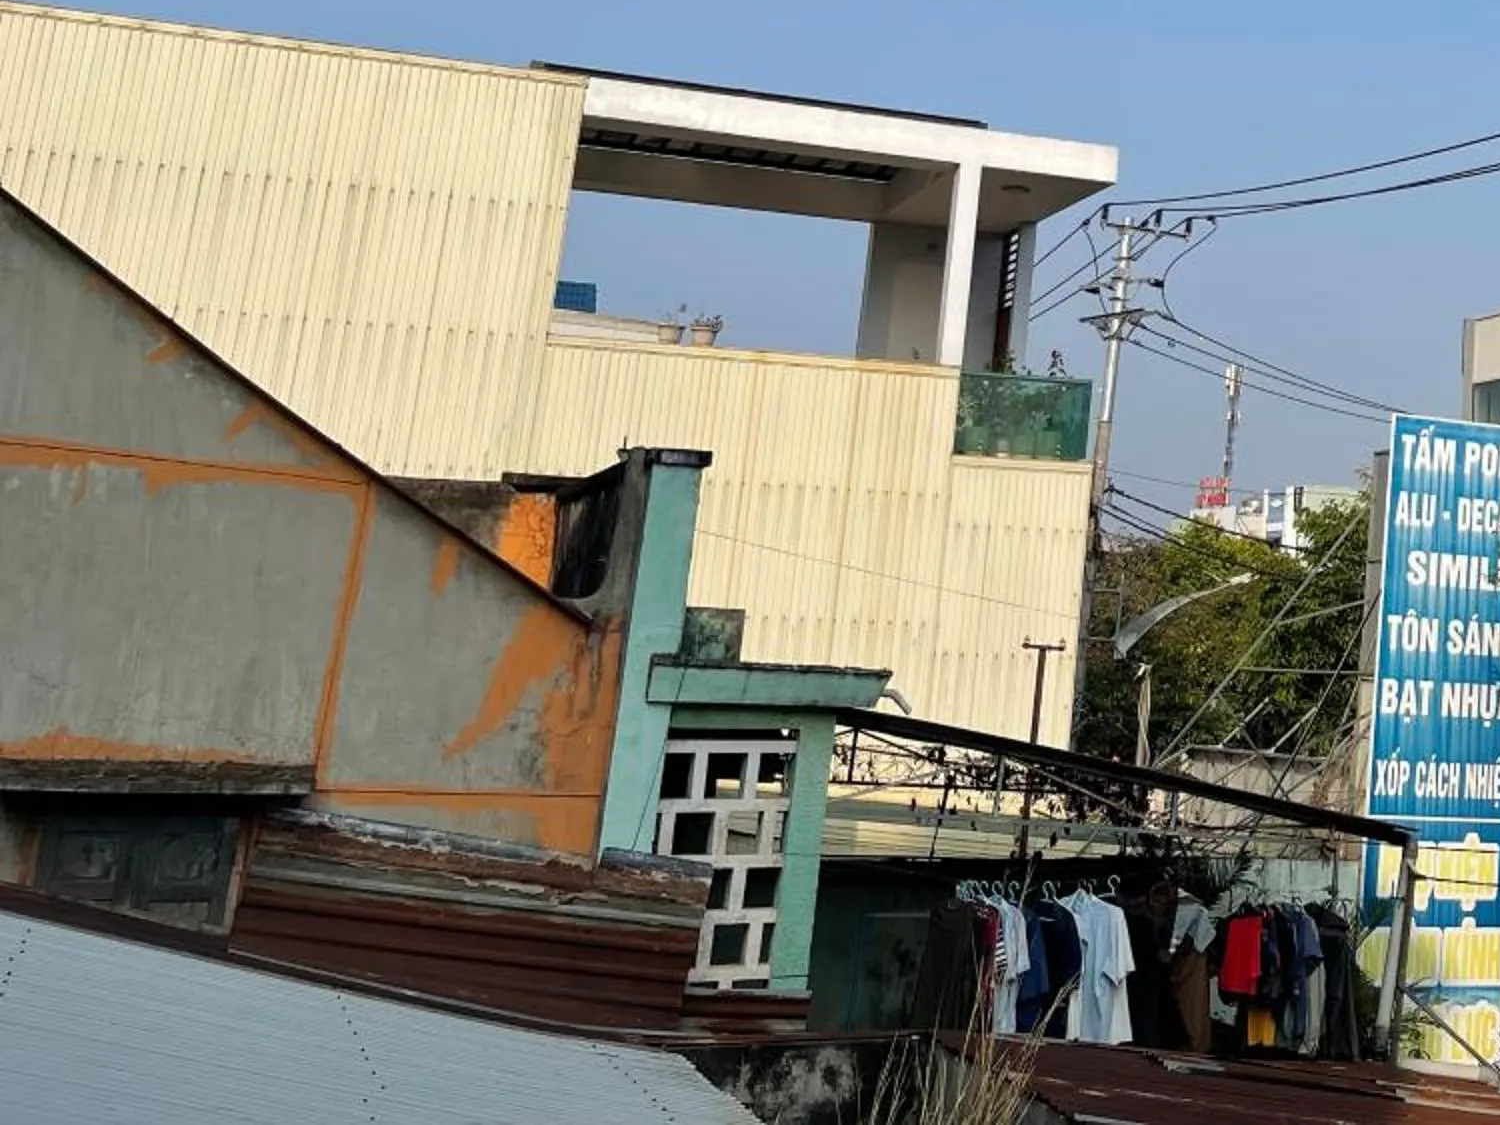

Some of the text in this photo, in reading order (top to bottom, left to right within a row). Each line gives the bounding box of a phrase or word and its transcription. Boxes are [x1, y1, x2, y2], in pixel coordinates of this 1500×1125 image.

[1401, 424, 1456, 473] TẤM
[1394, 490, 1437, 527] ALU
[1387, 609, 1439, 653] TÔN
[1380, 678, 1433, 723] BẠT
[1374, 747, 1410, 796] XỐP
[1415, 754, 1461, 798] CÁCH
